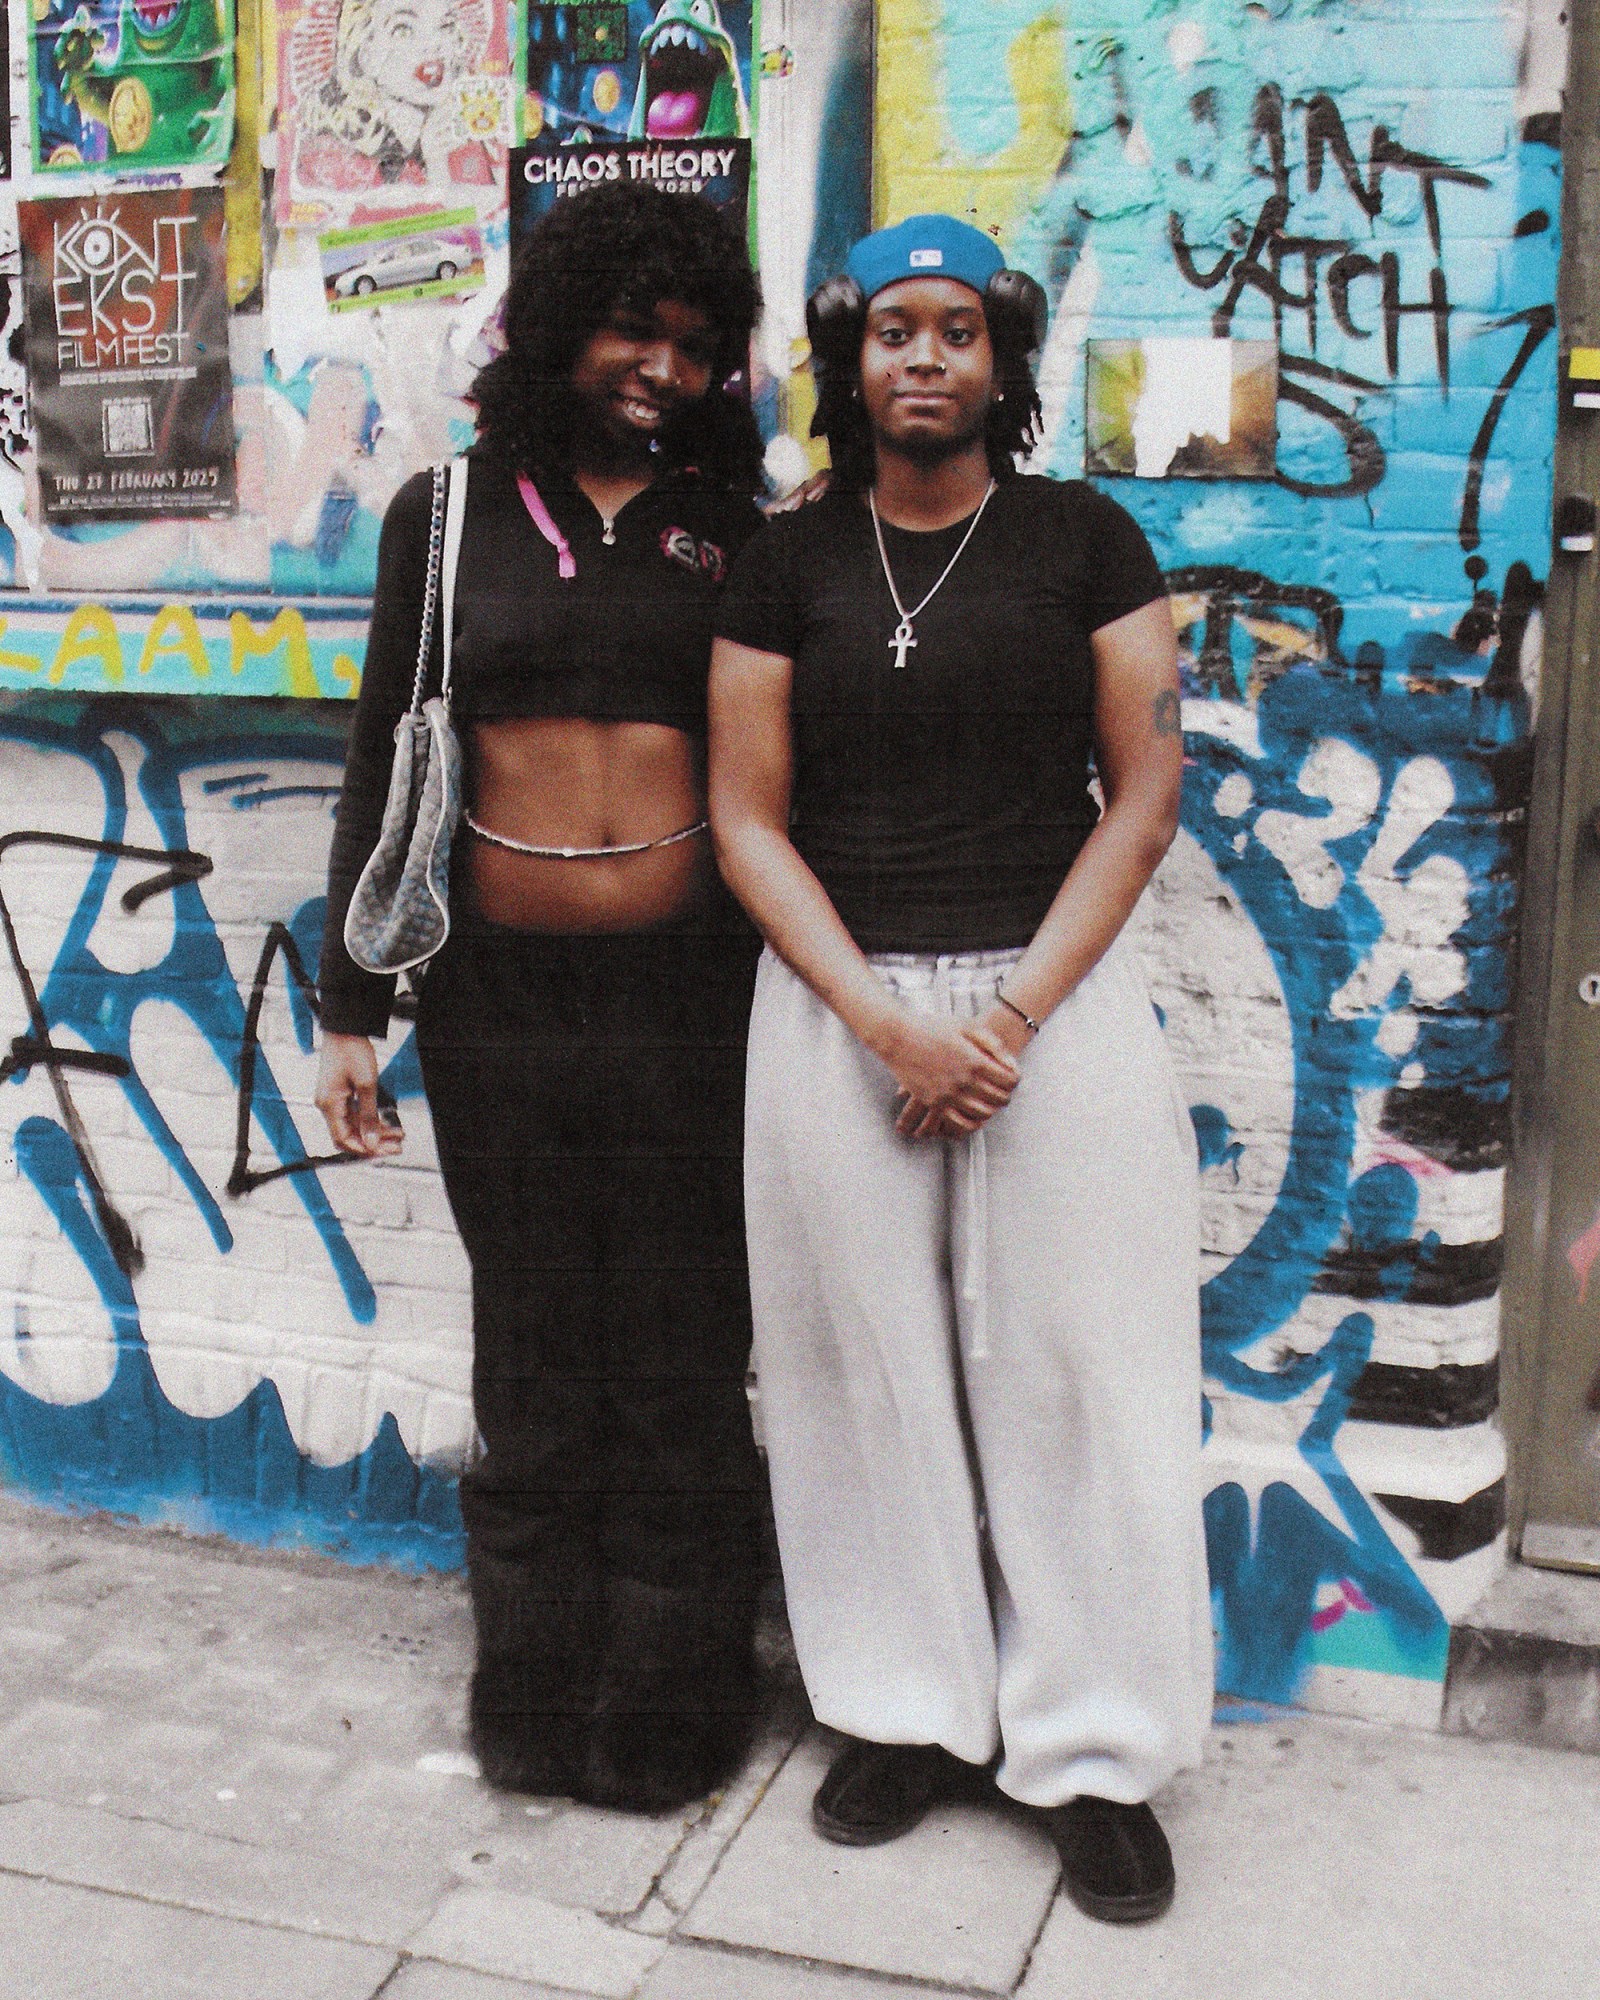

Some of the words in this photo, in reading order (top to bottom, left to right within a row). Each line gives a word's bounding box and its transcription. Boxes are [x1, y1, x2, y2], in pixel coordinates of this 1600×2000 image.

[523, 150, 622, 184] CHAOS
[626, 147, 737, 181] THEORY
[54, 474, 80, 492] THU
[86, 471, 102, 490] 27
[110, 467, 177, 493] FEBRUARY
[182, 464, 220, 488] 2025
